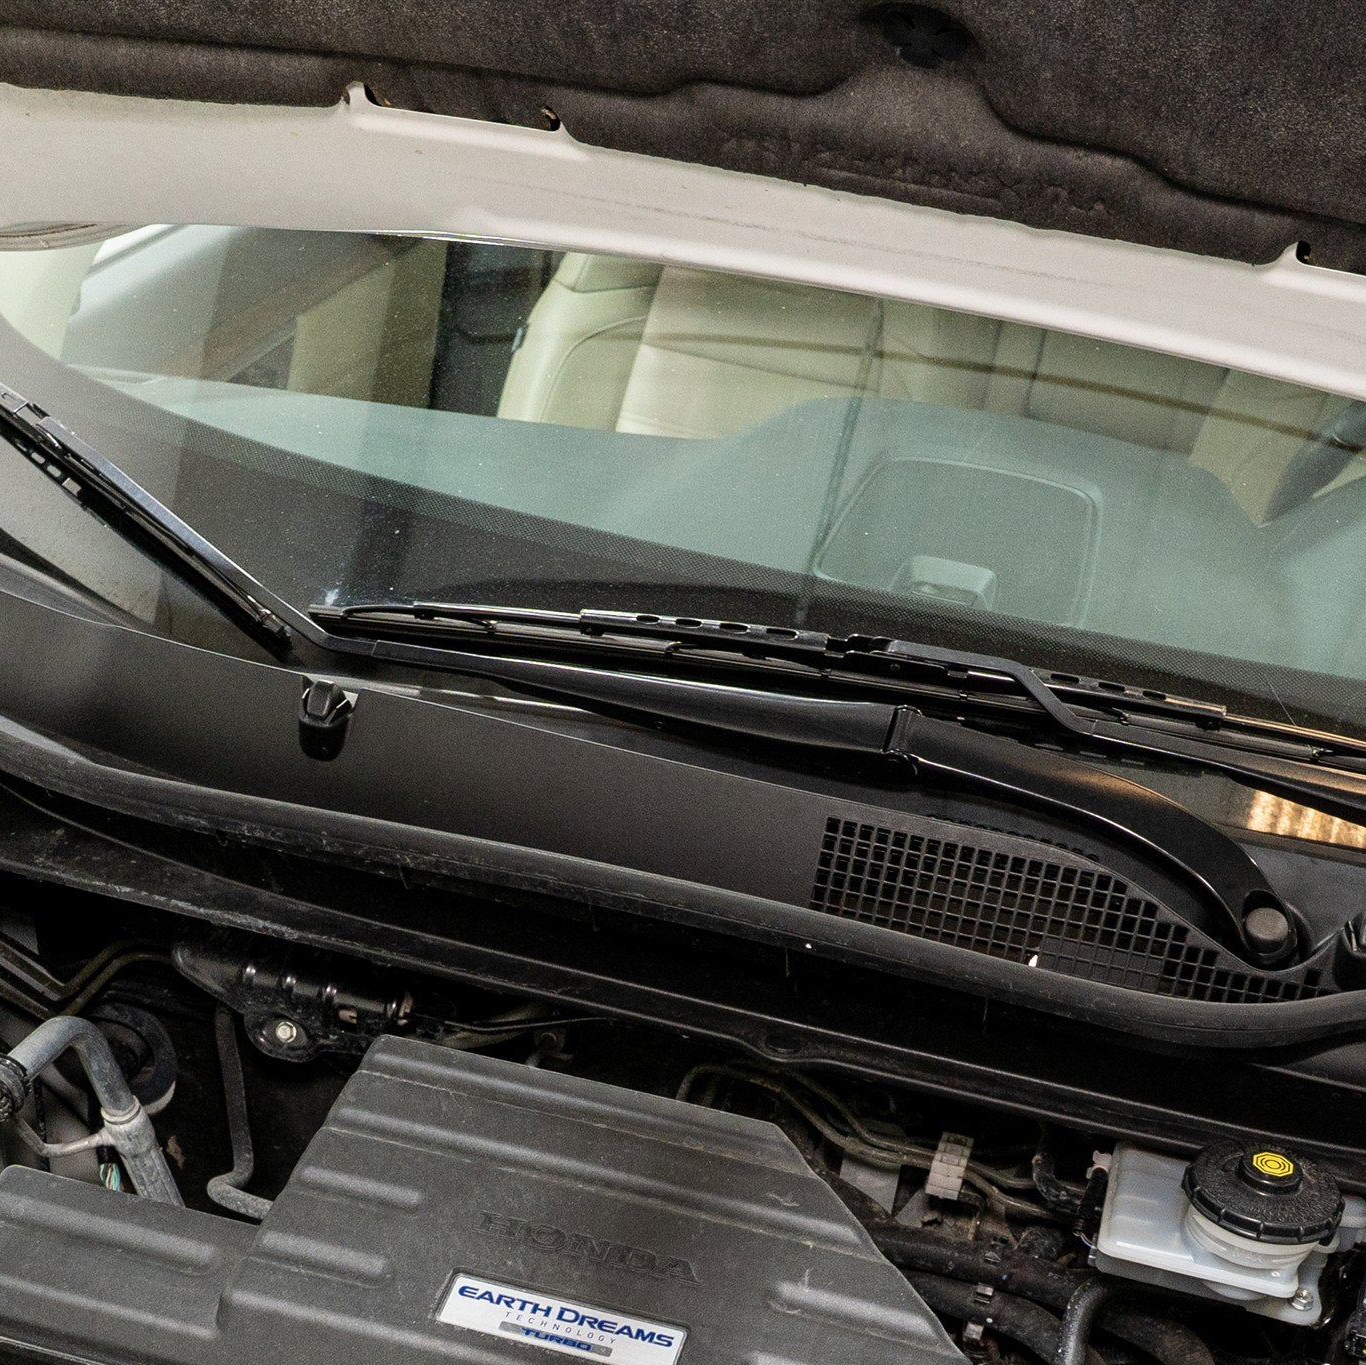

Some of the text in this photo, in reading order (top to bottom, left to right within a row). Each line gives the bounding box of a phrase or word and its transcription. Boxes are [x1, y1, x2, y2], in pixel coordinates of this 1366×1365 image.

[473, 1211, 701, 1285] HONDA
[458, 1285, 675, 1348] EARTH DREAMS
[505, 1311, 618, 1345] TECHNOLOGY
[522, 1326, 594, 1352] TURBO
